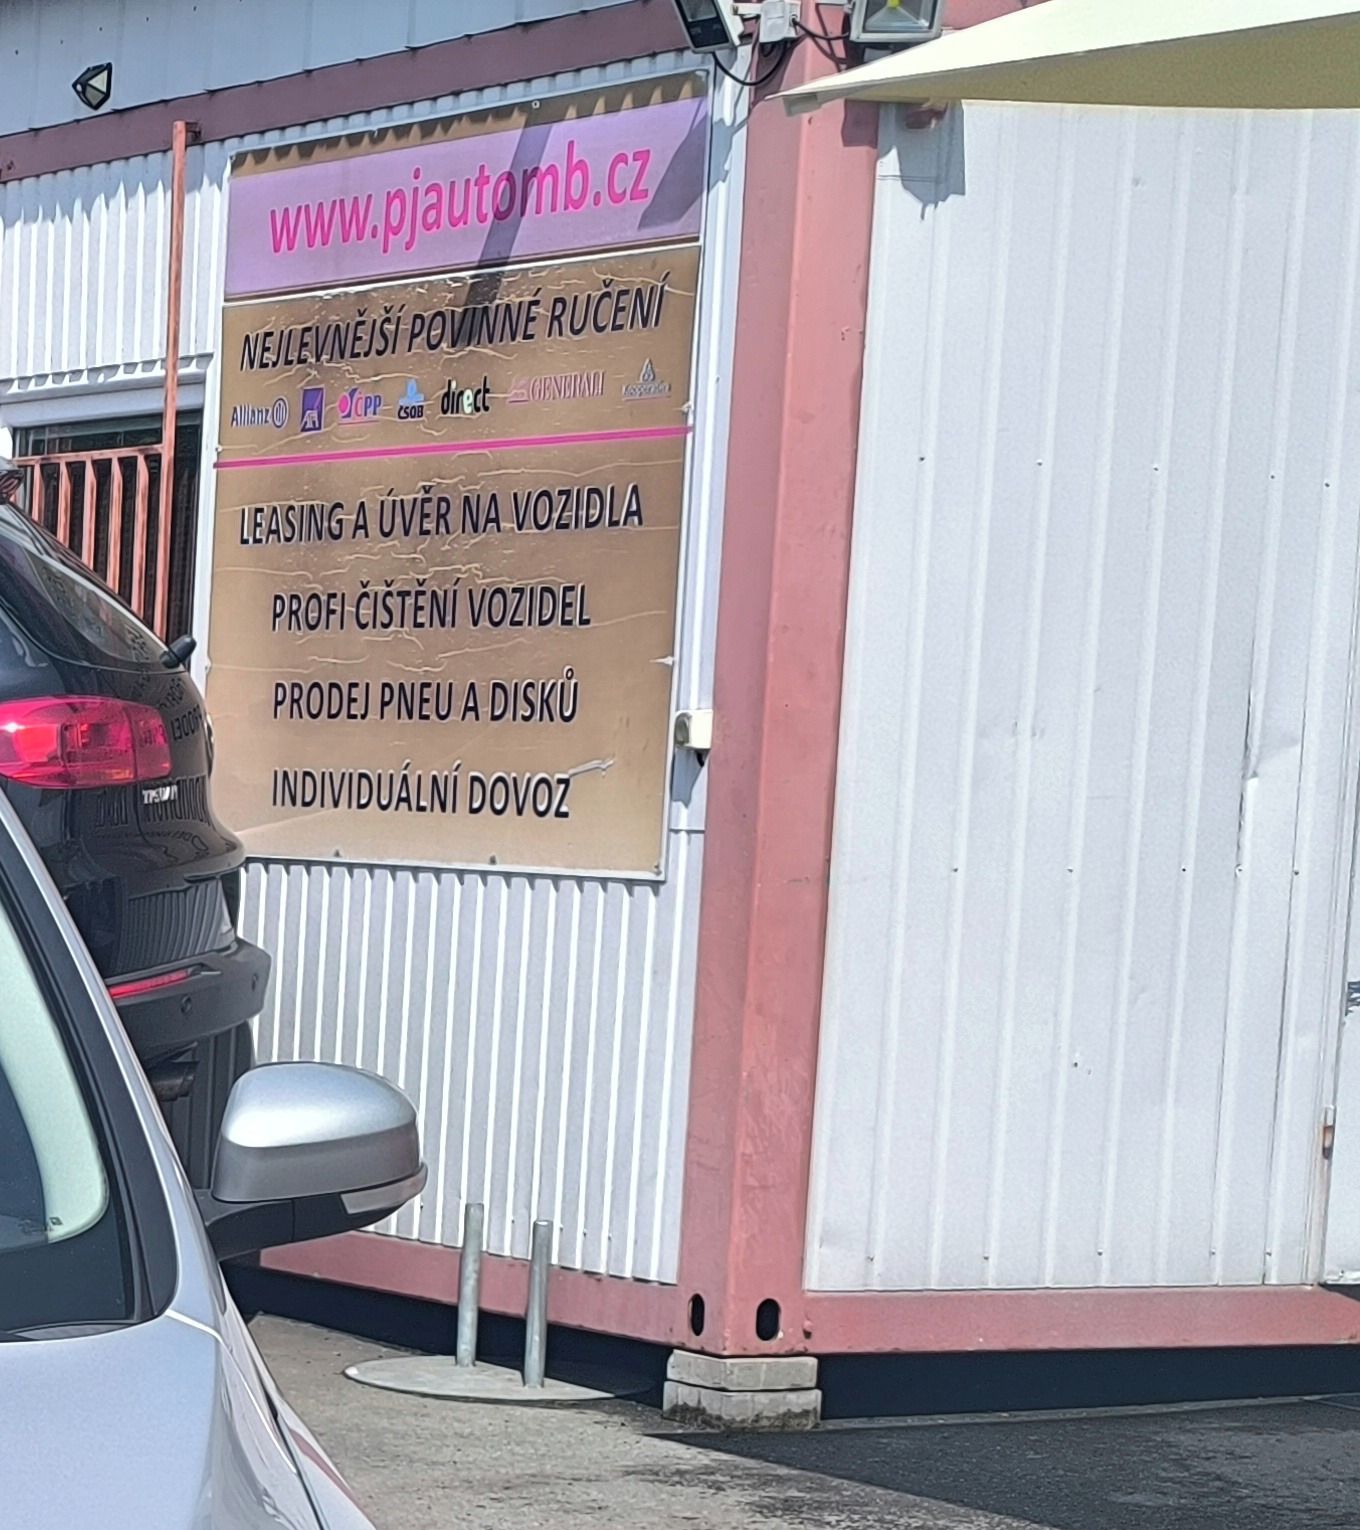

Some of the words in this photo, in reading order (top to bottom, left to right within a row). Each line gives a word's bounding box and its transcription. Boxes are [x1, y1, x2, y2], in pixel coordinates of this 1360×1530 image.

[269, 140, 651, 254] www.pjautomb.cz
[239, 303, 403, 372] NEJLEVNĚJŠÍ
[408, 289, 539, 354] POVINNÉ
[547, 271, 671, 337] RUČENÍ
[231, 403, 271, 428] Allianz
[441, 375, 490, 415] direct
[239, 500, 345, 546] LEASING
[352, 501, 370, 539] A
[379, 486, 452, 538] ÚVĚR
[461, 495, 503, 535] NA
[512, 483, 644, 532] VOZIDLA
[272, 592, 346, 631] PROFI
[354, 577, 461, 631] ČIŠTĚNÍ
[468, 583, 591, 629] VOZIDEL
[273, 680, 371, 721] PRODEJ
[380, 681, 453, 722] PNEU
[461, 681, 480, 722] A
[489, 666, 579, 723] DISKŮ
[271, 761, 462, 815] INDIVIDUÁLNÍ
[467, 775, 571, 819] DOVOZ
